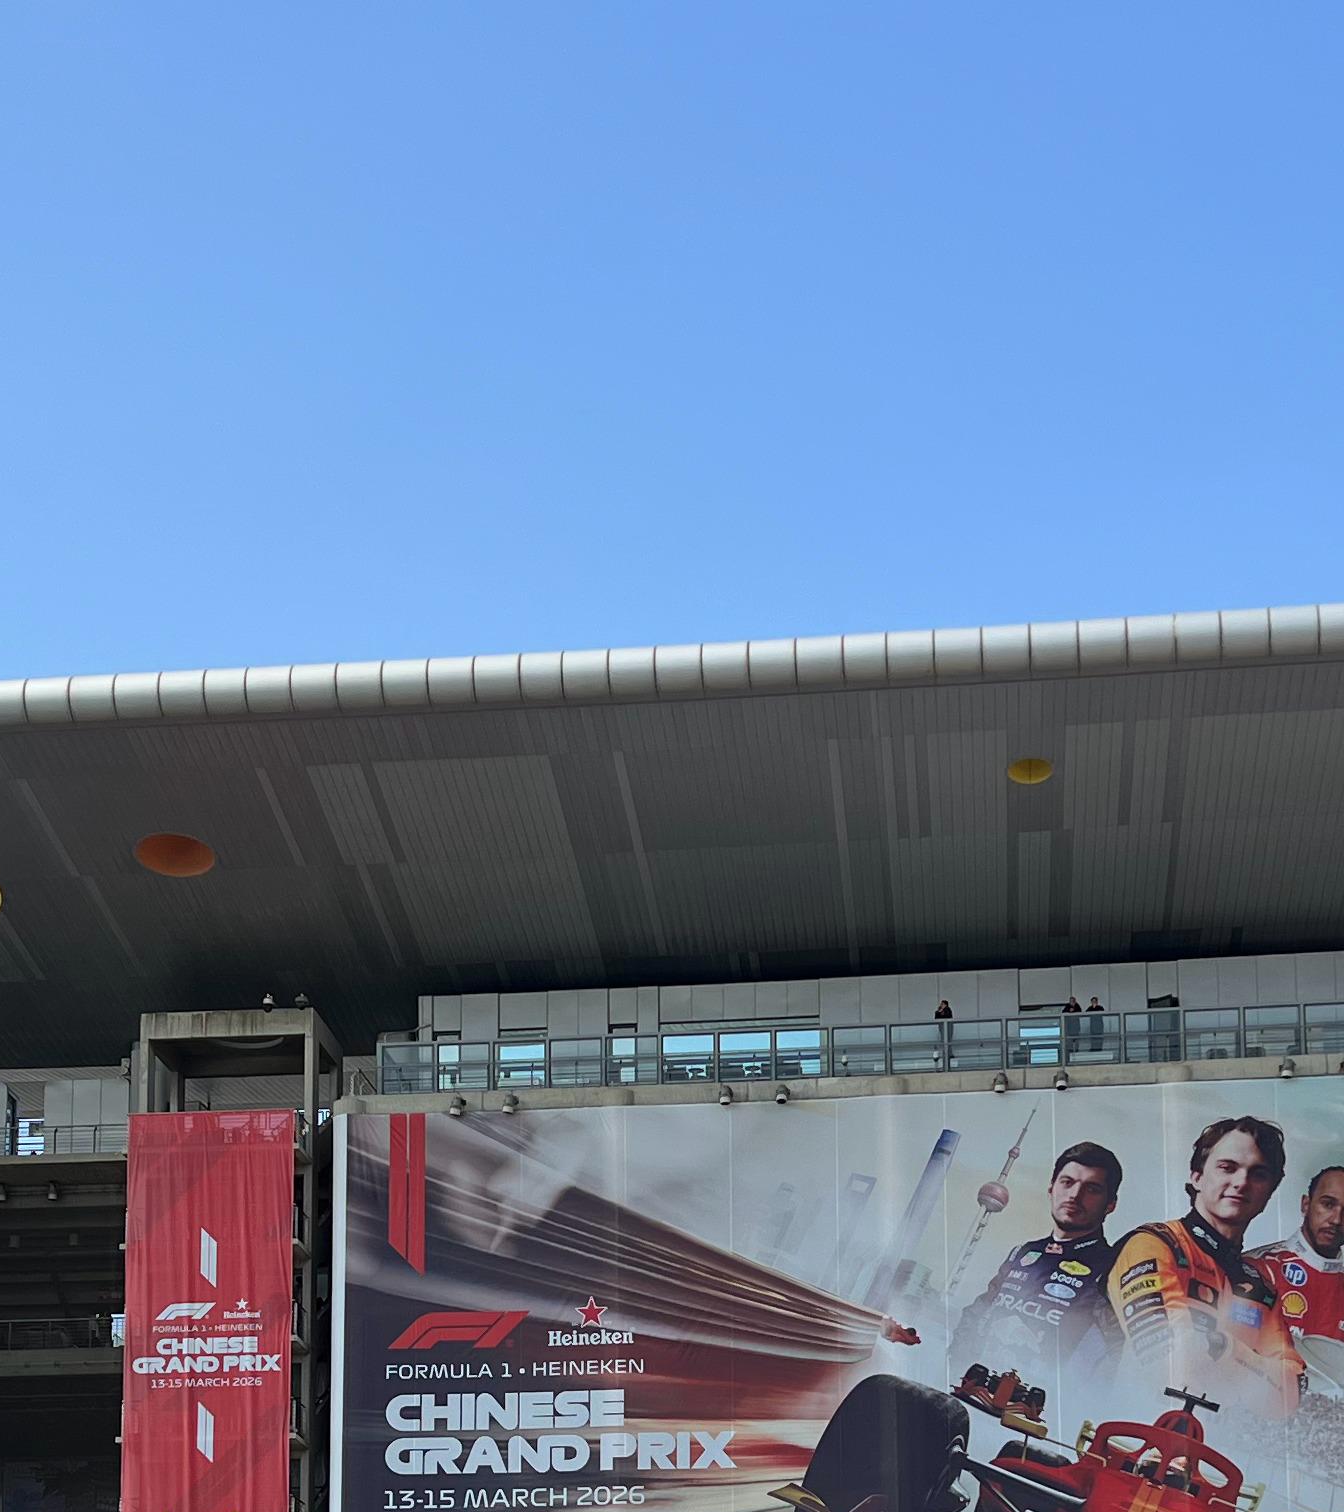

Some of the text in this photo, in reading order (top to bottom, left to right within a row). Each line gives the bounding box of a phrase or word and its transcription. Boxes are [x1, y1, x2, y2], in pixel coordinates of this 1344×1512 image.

[152, 1325, 199, 1334] FORMULA
[214, 1323, 263, 1332] HEINEKEN
[547, 1328, 635, 1347] Heineken
[155, 1336, 259, 1356] CHINESE
[131, 1353, 282, 1375] GRAND PRIX
[385, 1358, 645, 1380] FORMULA 1 HEINEKEN
[150, 1376, 263, 1389] 13-15 MARCH 2026
[385, 1388, 625, 1432] CHINESE
[384, 1430, 738, 1475] GRAND PRIX
[383, 1485, 646, 1510] 13-15 MARCH 2026
